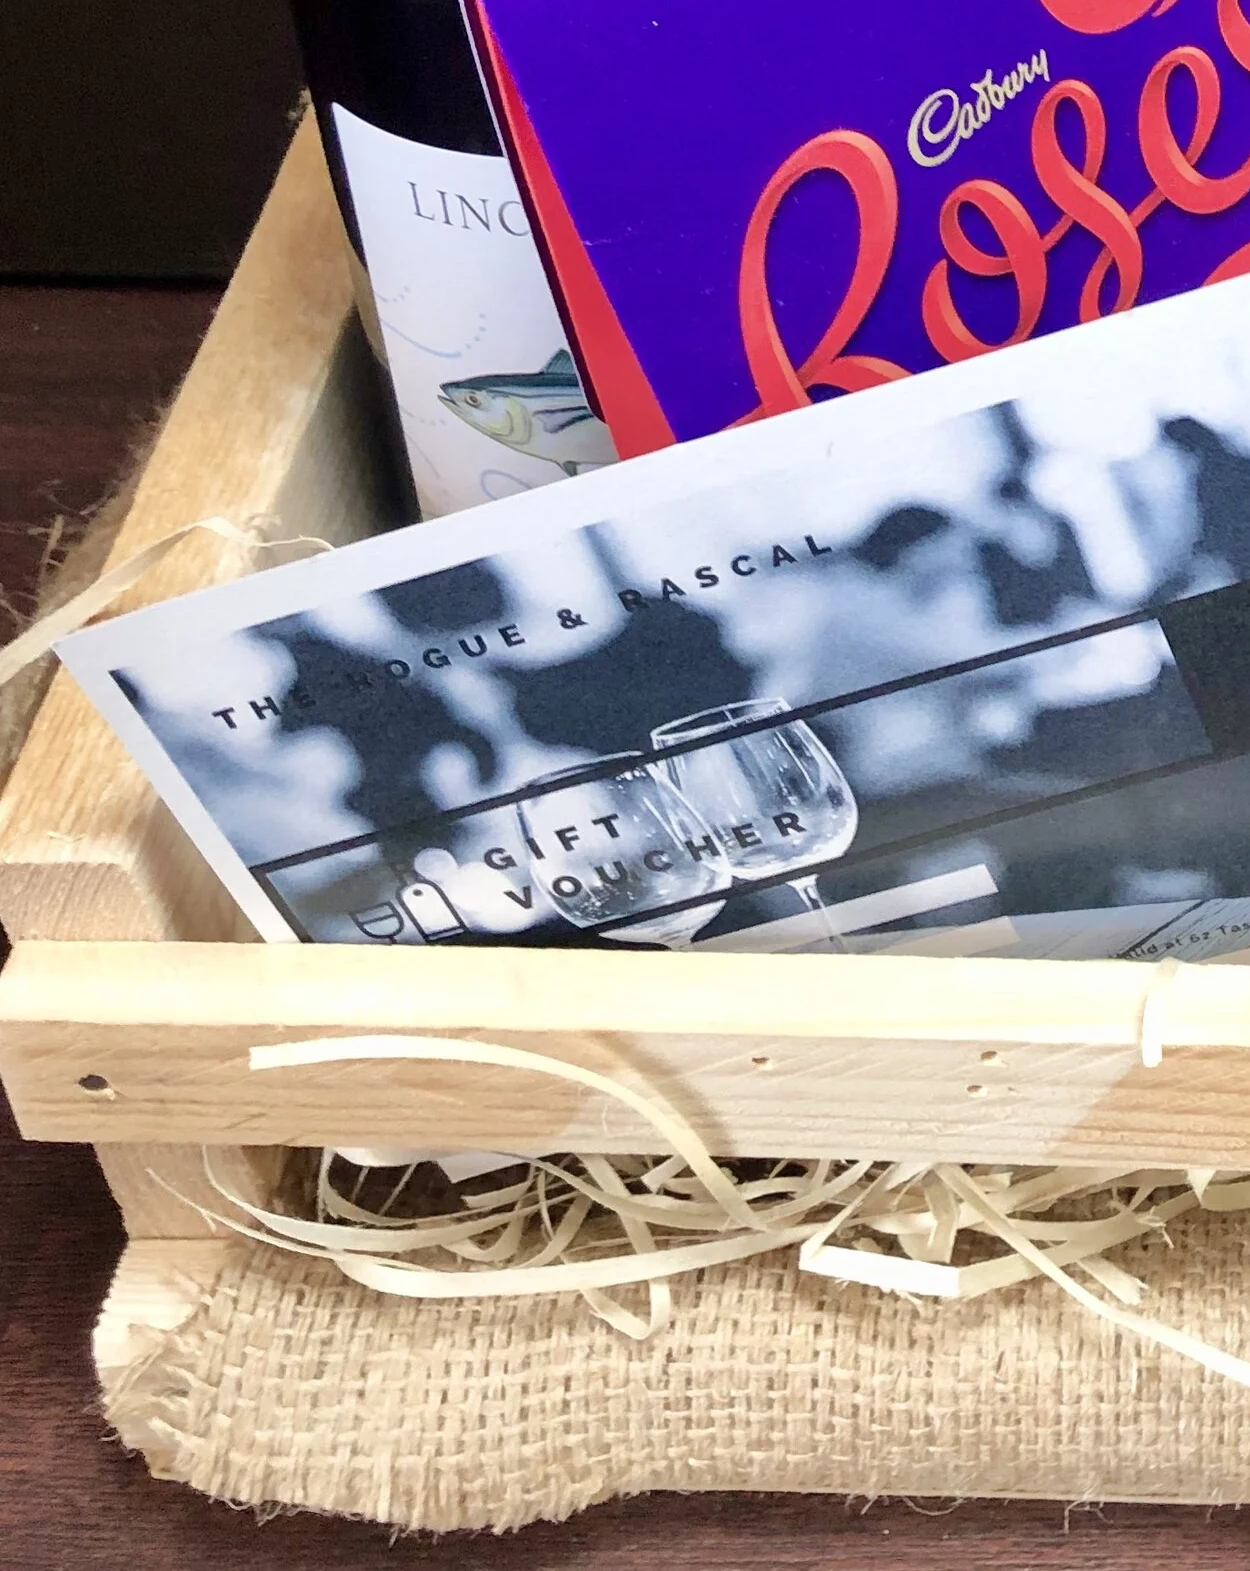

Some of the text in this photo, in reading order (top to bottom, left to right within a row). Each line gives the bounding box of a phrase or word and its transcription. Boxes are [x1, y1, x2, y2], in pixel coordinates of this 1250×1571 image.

[906, 48, 1051, 168] Cadbury
[211, 692, 317, 730] THE
[556, 608, 589, 630] &
[617, 533, 833, 613] RASCAL
[482, 812, 621, 871] GIFT
[503, 811, 808, 910] VOUCHER
